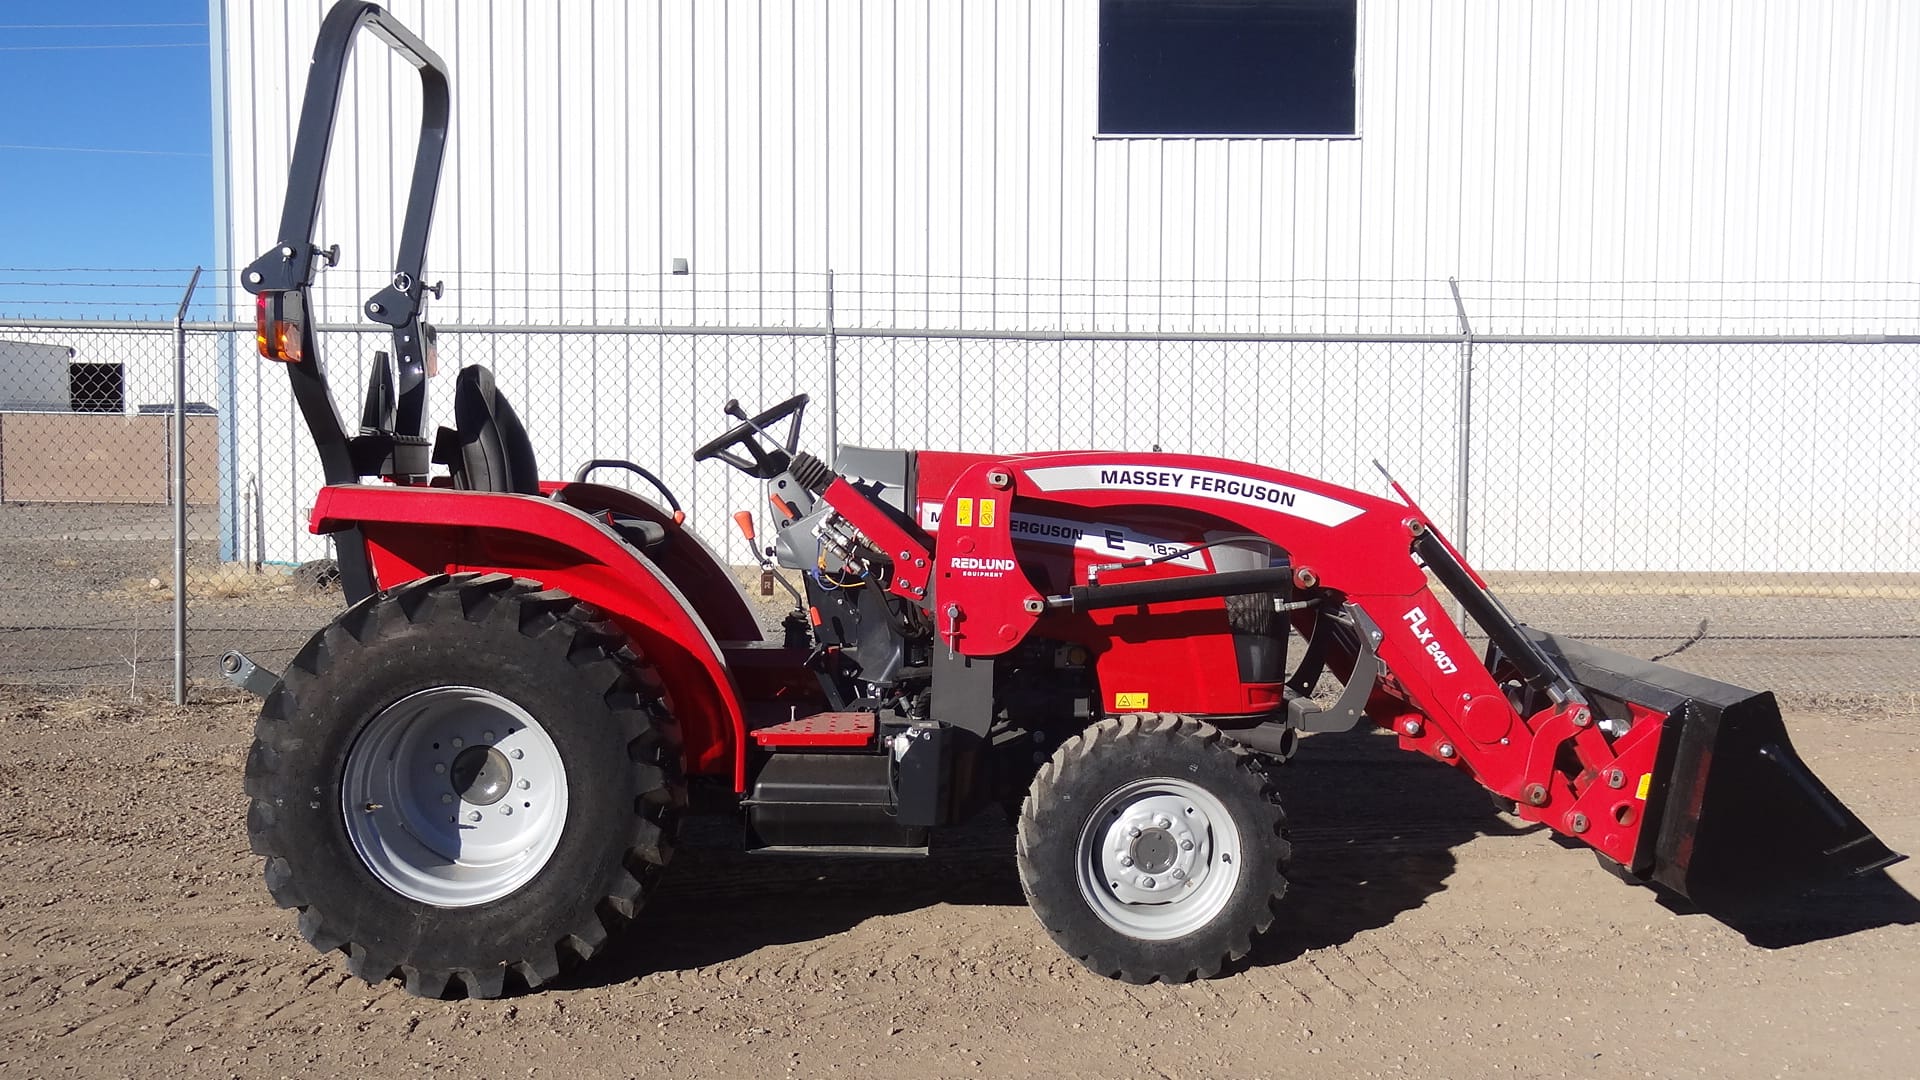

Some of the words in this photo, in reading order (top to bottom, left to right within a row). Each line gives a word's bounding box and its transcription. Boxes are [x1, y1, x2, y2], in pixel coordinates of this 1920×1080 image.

[1101, 470, 1183, 488] MASSEY
[1190, 475, 1296, 507] FERGUSON
[1010, 520, 1083, 540] ERGUSON
[1104, 529, 1125, 550] E
[951, 557, 1015, 571] REDLUND
[1425, 641, 1458, 675] 2407
